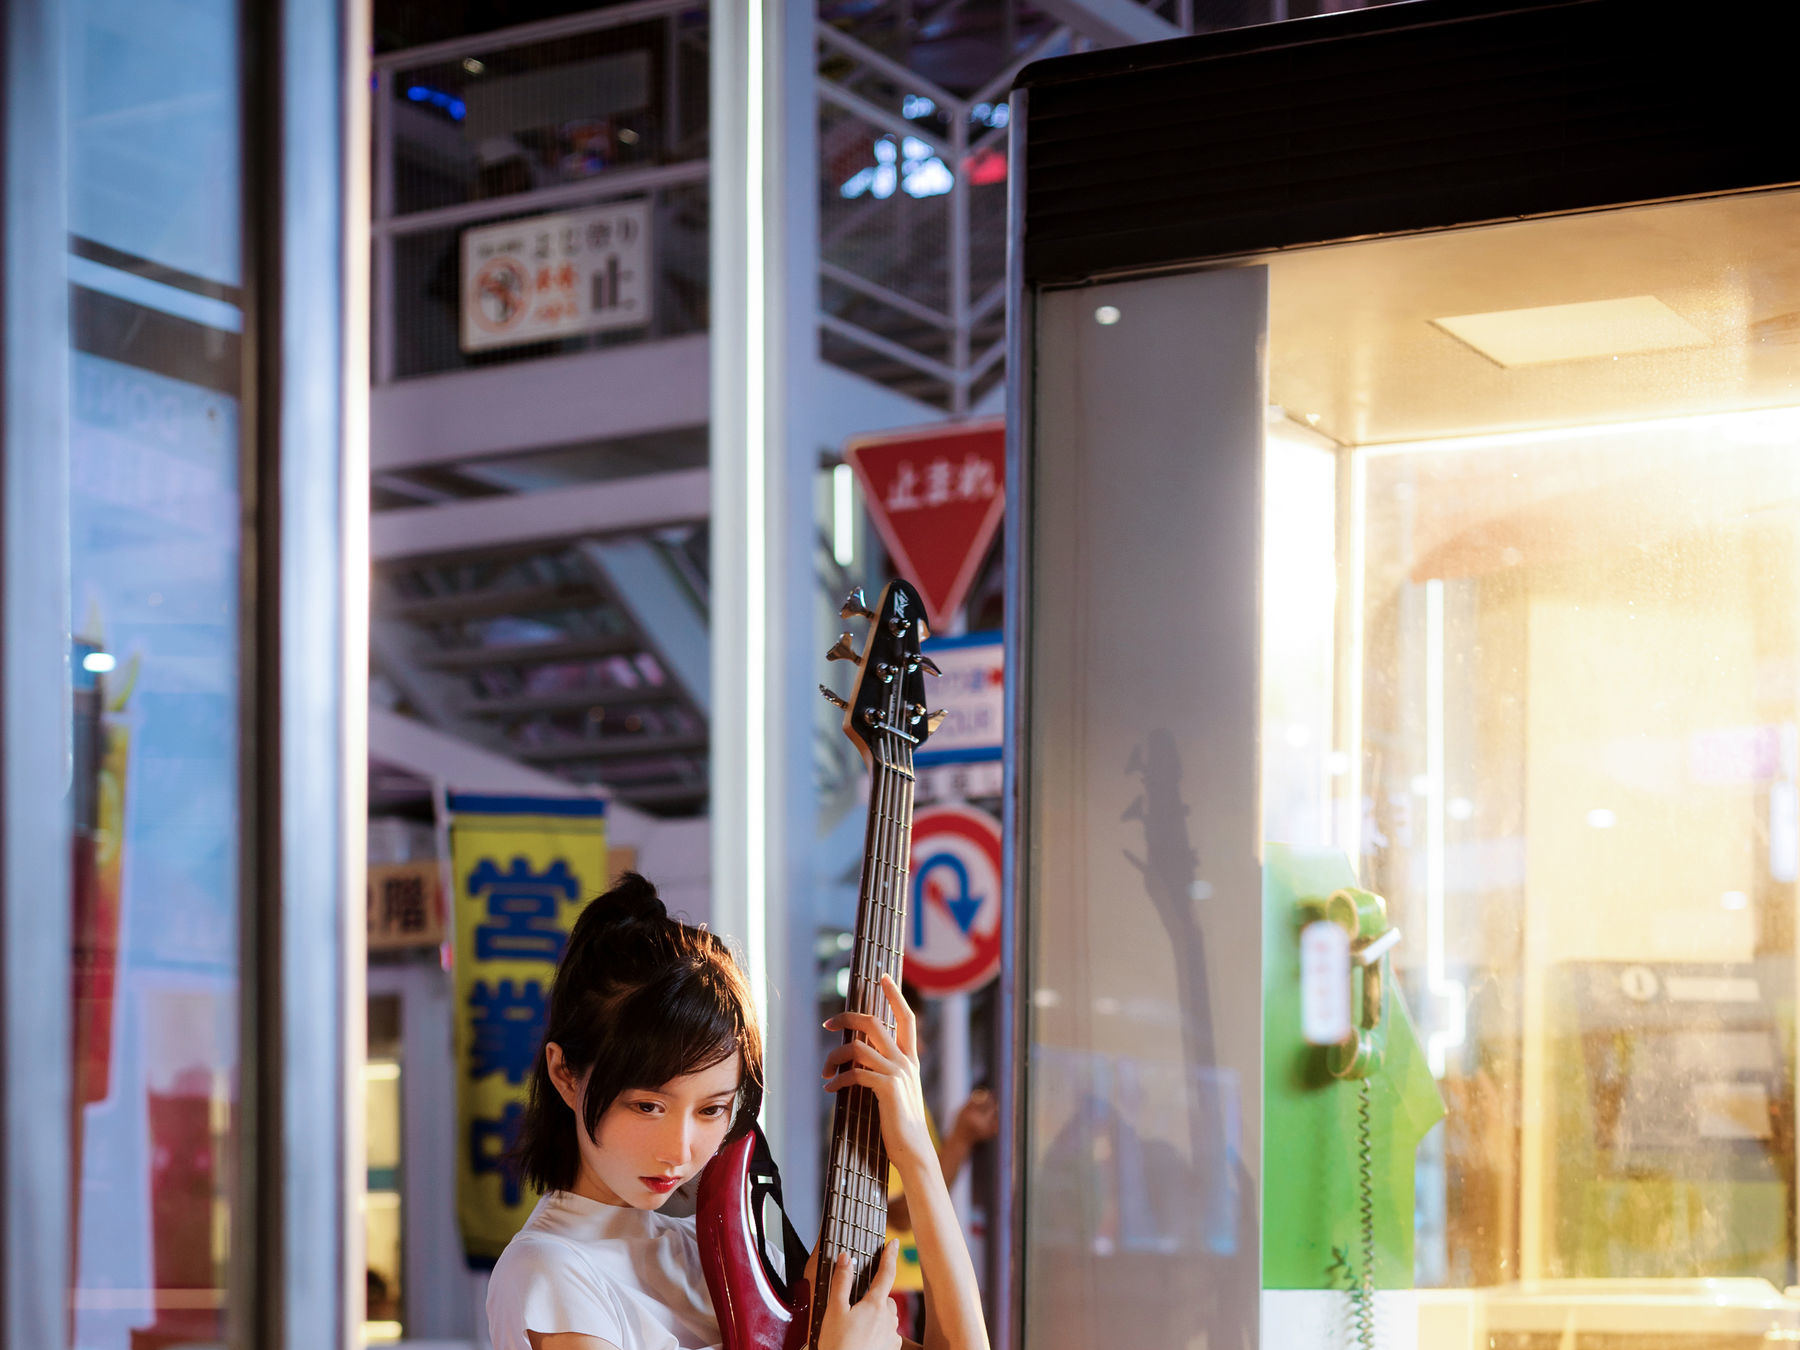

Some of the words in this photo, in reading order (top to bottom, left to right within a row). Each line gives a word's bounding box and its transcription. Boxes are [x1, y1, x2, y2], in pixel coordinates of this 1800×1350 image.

[887, 454, 996, 511] 止まれ
[367, 875, 428, 935] 階
[467, 856, 579, 1206] 営業中
